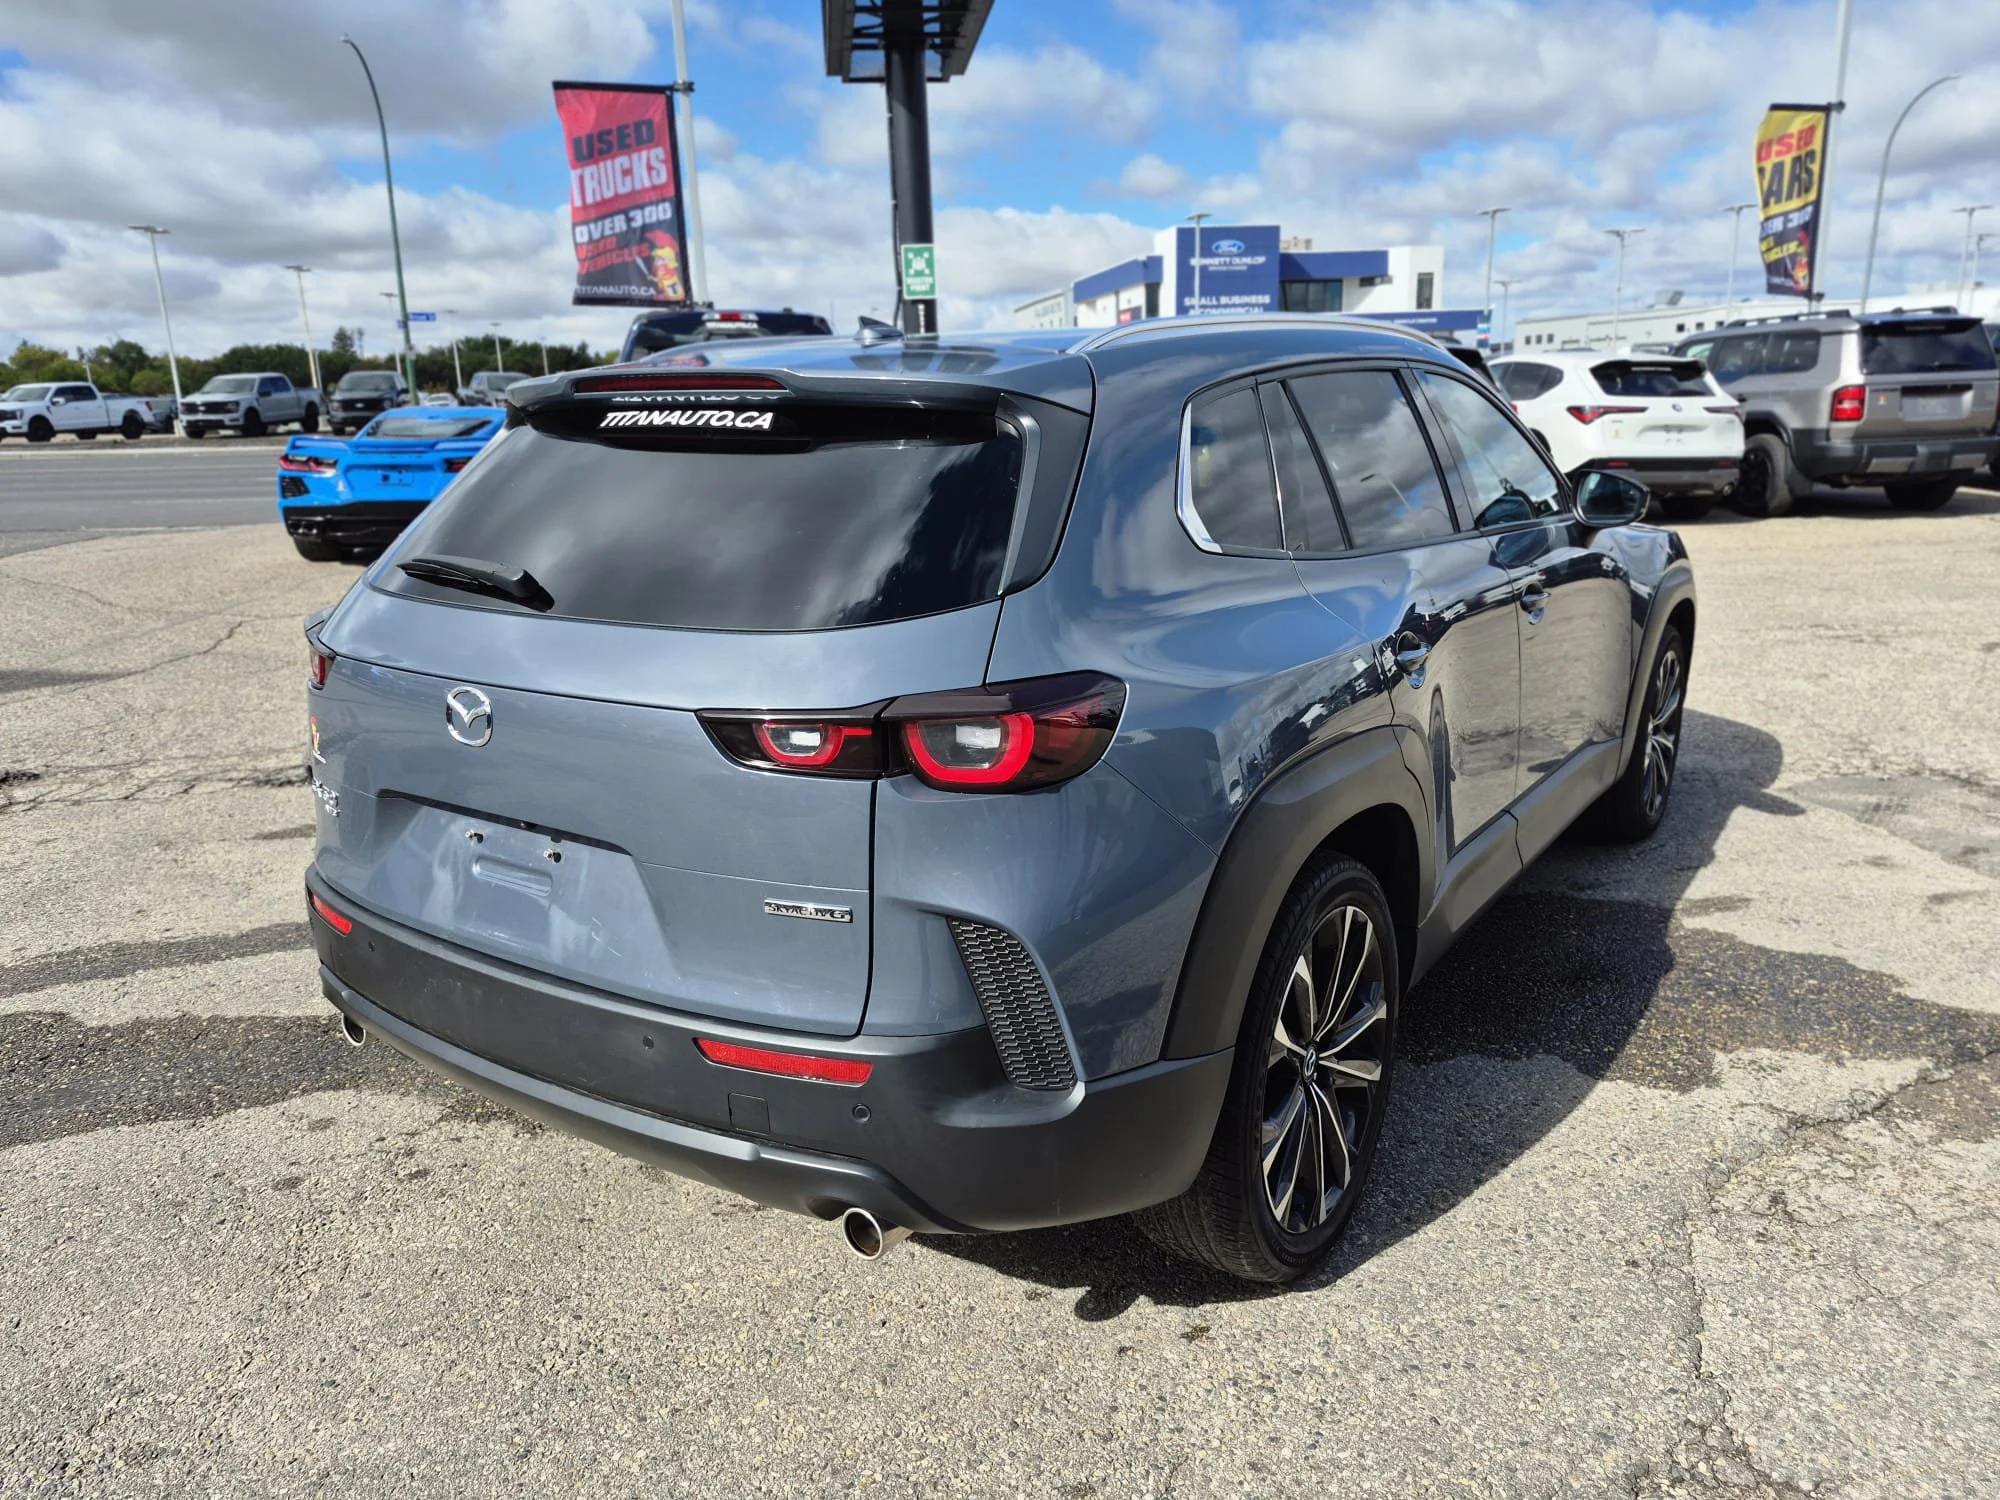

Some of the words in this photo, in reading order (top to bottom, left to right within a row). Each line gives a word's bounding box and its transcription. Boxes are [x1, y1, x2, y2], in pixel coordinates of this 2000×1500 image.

[573, 119, 655, 162] USED
[1757, 125, 1816, 164] USED
[571, 147, 667, 207] TRUCKS
[575, 214, 627, 244] OVER
[628, 202, 672, 228] 300
[576, 284, 656, 295] TITANAUTO.CA
[1219, 295, 1270, 304] BUSINESS
[600, 411, 774, 429] TITANAUTO.CA
